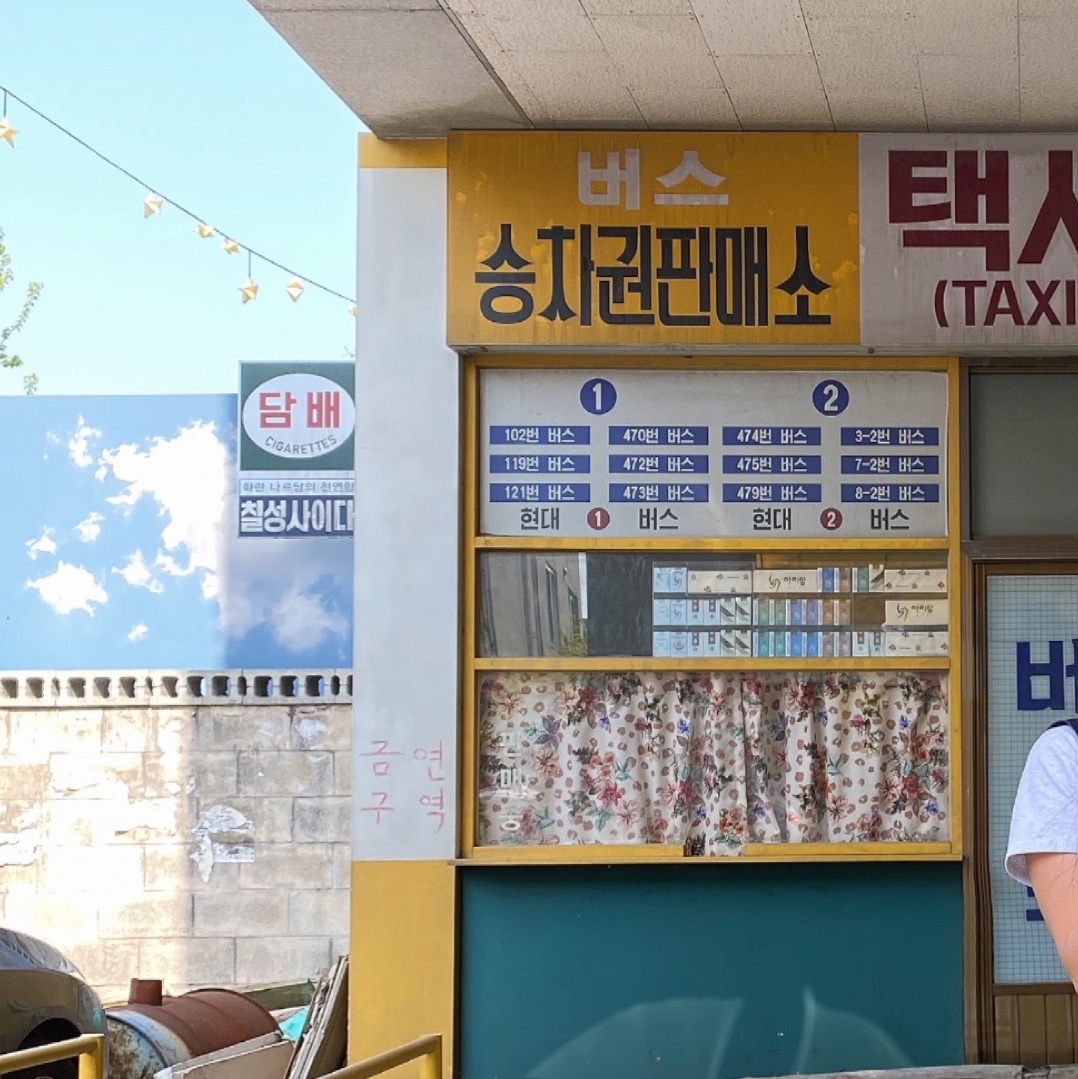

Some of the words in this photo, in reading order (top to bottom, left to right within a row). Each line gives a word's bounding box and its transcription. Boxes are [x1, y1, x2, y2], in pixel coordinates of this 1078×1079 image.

[577, 148, 729, 211] 버스
[474, 223, 832, 326] 승차권판매소
[259, 391, 340, 428] 담배
[505, 428, 539, 444] 102번
[548, 428, 575, 444] 버스
[622, 428, 659, 444] 470번
[668, 428, 694, 444] 버스
[737, 428, 772, 444] 474번
[780, 428, 807, 444] 버스
[855, 428, 890, 444] 3-2번
[899, 428, 924, 444] 버스
[265, 435, 337, 455] CIGARETTES
[505, 457, 539, 472] 119번
[548, 457, 575, 472] 버스
[622, 457, 659, 472] 472번
[668, 457, 694, 472] 버스
[737, 458, 772, 472] 475번
[780, 458, 807, 472] 버스
[855, 458, 890, 472] 7-2번
[899, 458, 924, 472] 버스
[505, 486, 539, 500] 121번
[548, 486, 575, 500] 버스
[622, 486, 659, 500] 473번
[668, 486, 694, 500] 버스
[737, 486, 772, 501] 479번
[780, 486, 807, 501] 버스
[855, 486, 890, 501] 8-2번
[899, 486, 924, 501] 버스
[241, 499, 355, 532] 칠성사이다
[520, 507, 560, 530] 현대
[639, 507, 678, 530] 버스
[753, 508, 791, 530] 현대
[870, 508, 909, 530] 버스
